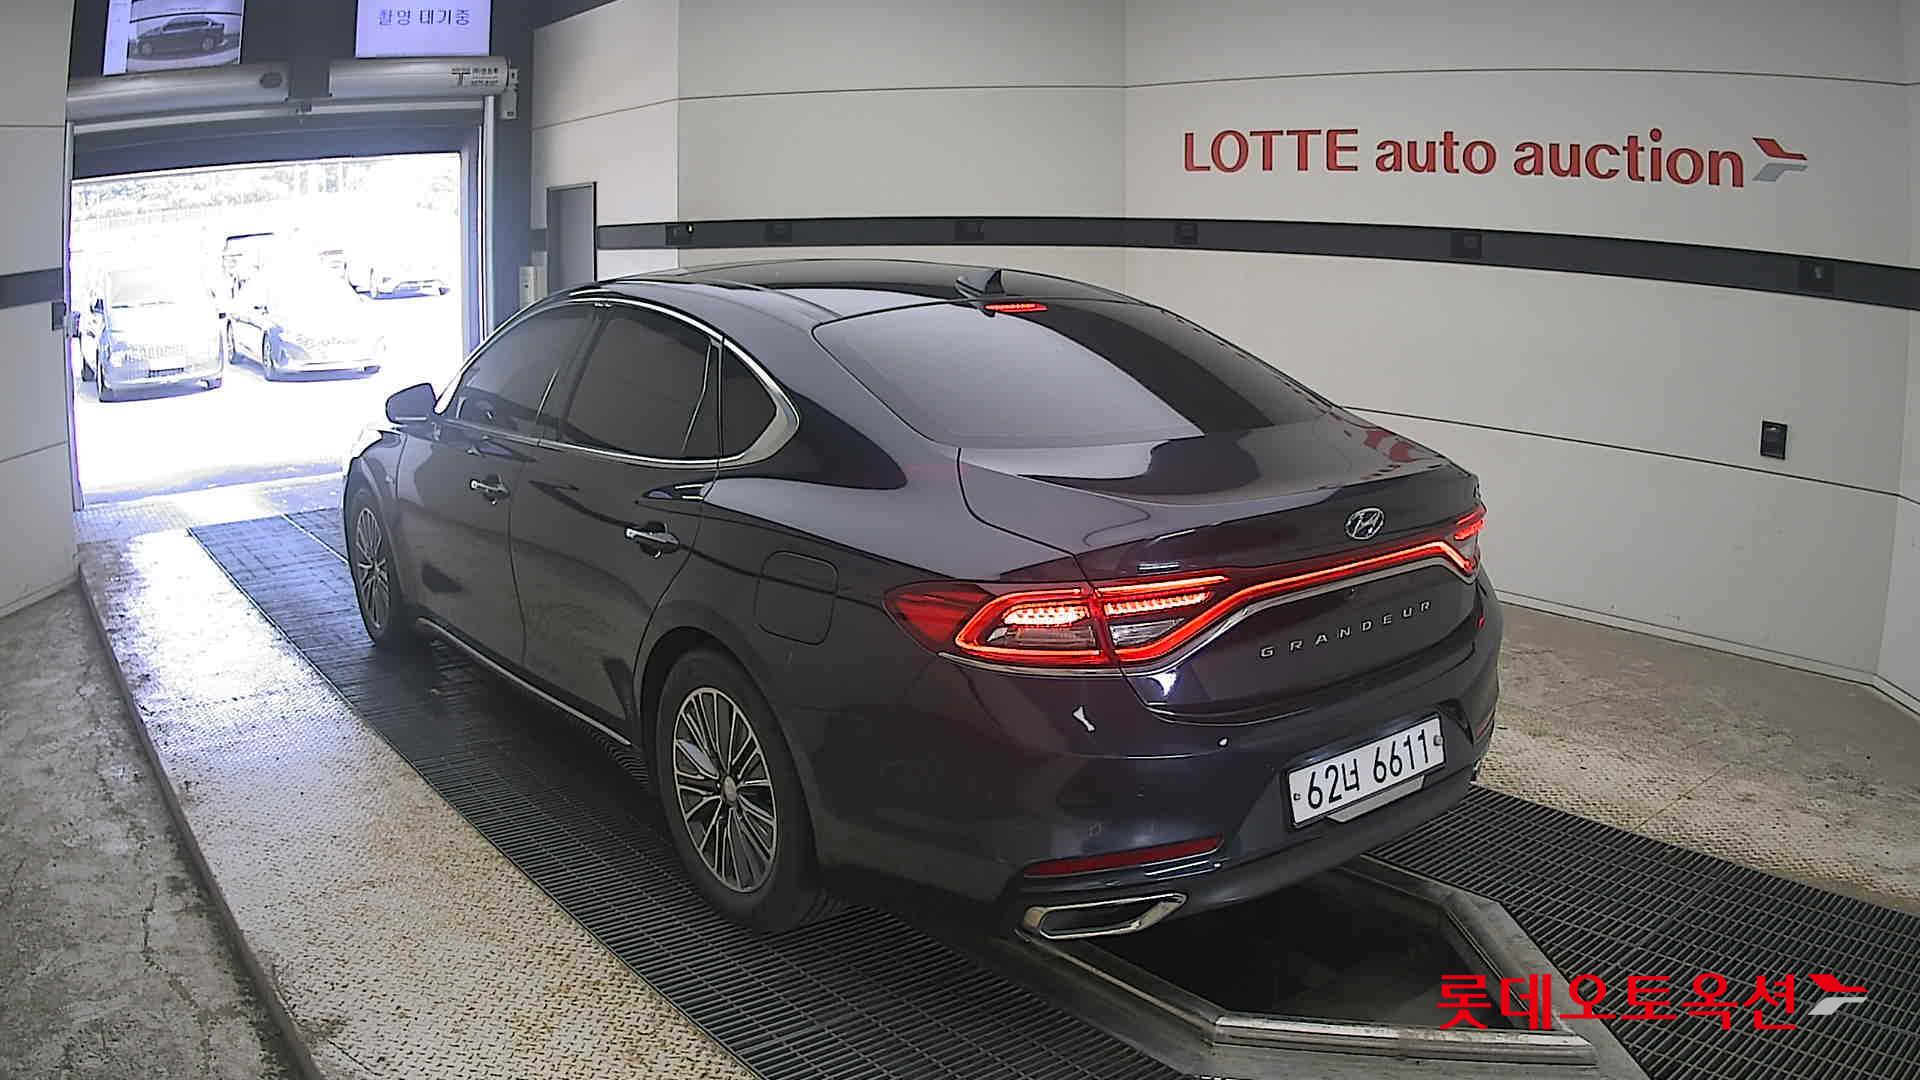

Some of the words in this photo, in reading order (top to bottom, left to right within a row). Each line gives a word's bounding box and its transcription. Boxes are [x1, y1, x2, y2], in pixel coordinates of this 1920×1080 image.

[419, 8, 471, 26] 대기중
[1184, 128, 1358, 172] LOTTE
[1376, 131, 1497, 175] auto
[1514, 128, 1744, 188] auction
[1260, 600, 1431, 659] GRANDEUR
[1307, 758, 1360, 809] 62너
[1373, 728, 1429, 783] 6611
